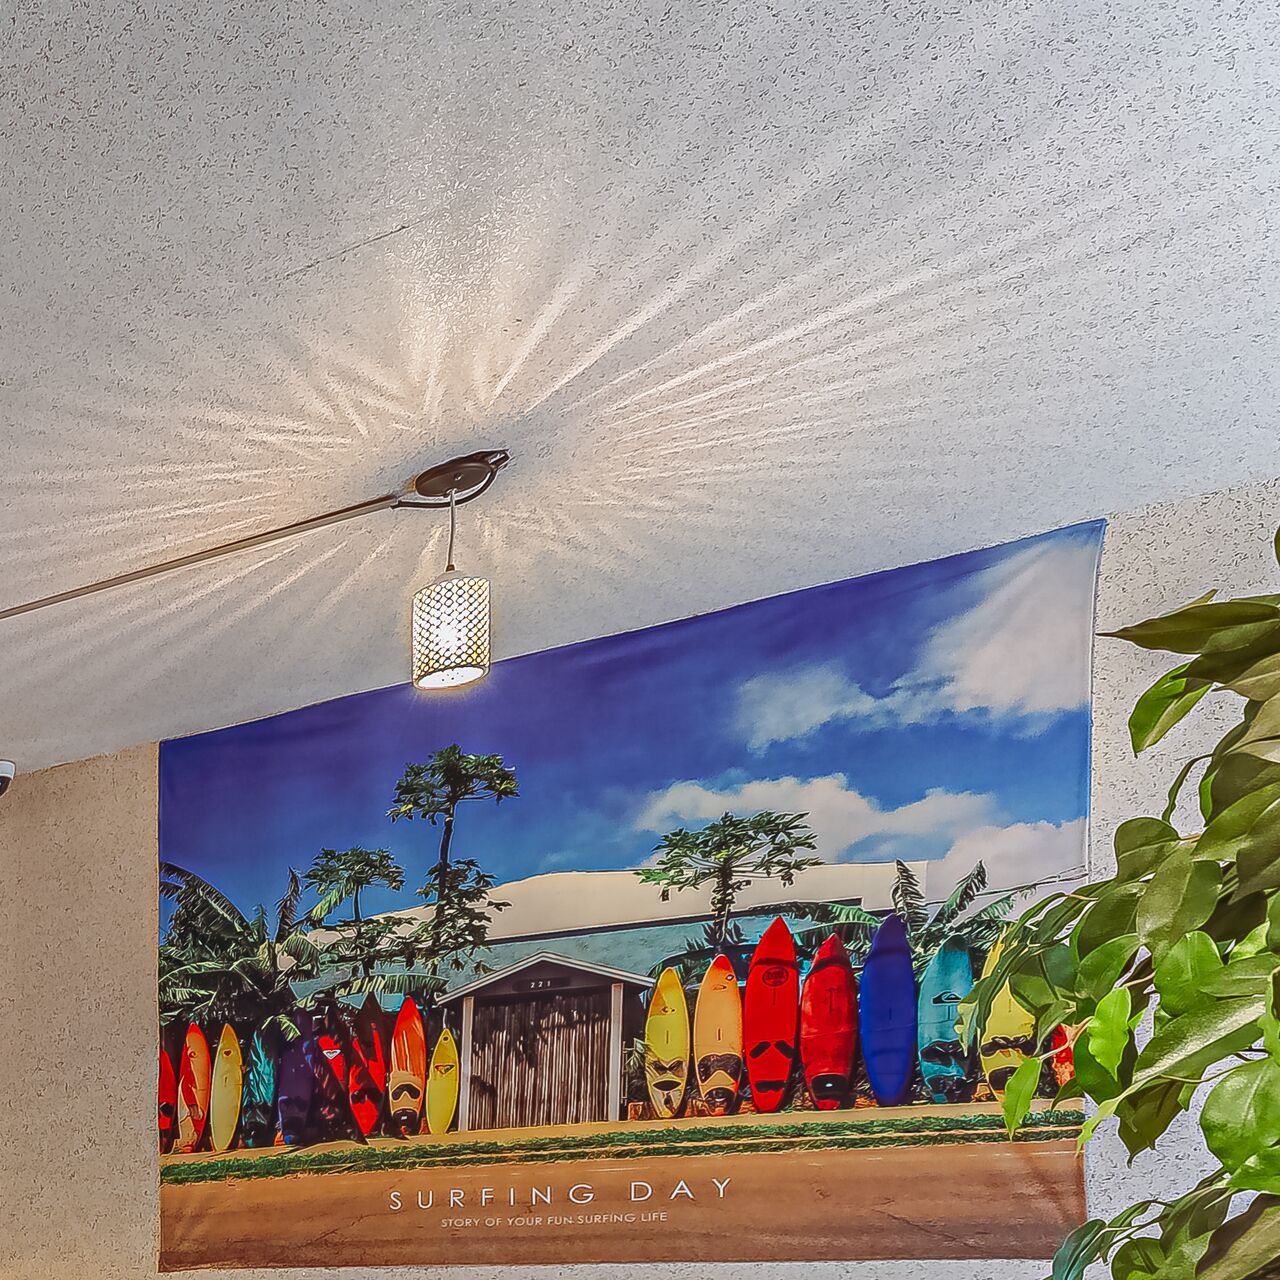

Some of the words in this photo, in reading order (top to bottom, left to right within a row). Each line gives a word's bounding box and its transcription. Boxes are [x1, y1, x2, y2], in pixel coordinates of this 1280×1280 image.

[389, 1182, 596, 1210] SURFING
[630, 1177, 732, 1202] DAY
[441, 1215, 480, 1228] STORY
[484, 1215, 502, 1227] OF
[507, 1214, 543, 1226] YOUR
[547, 1214, 574, 1226] FUN
[577, 1211, 636, 1225] SURFING
[640, 1211, 668, 1222] LIFE
